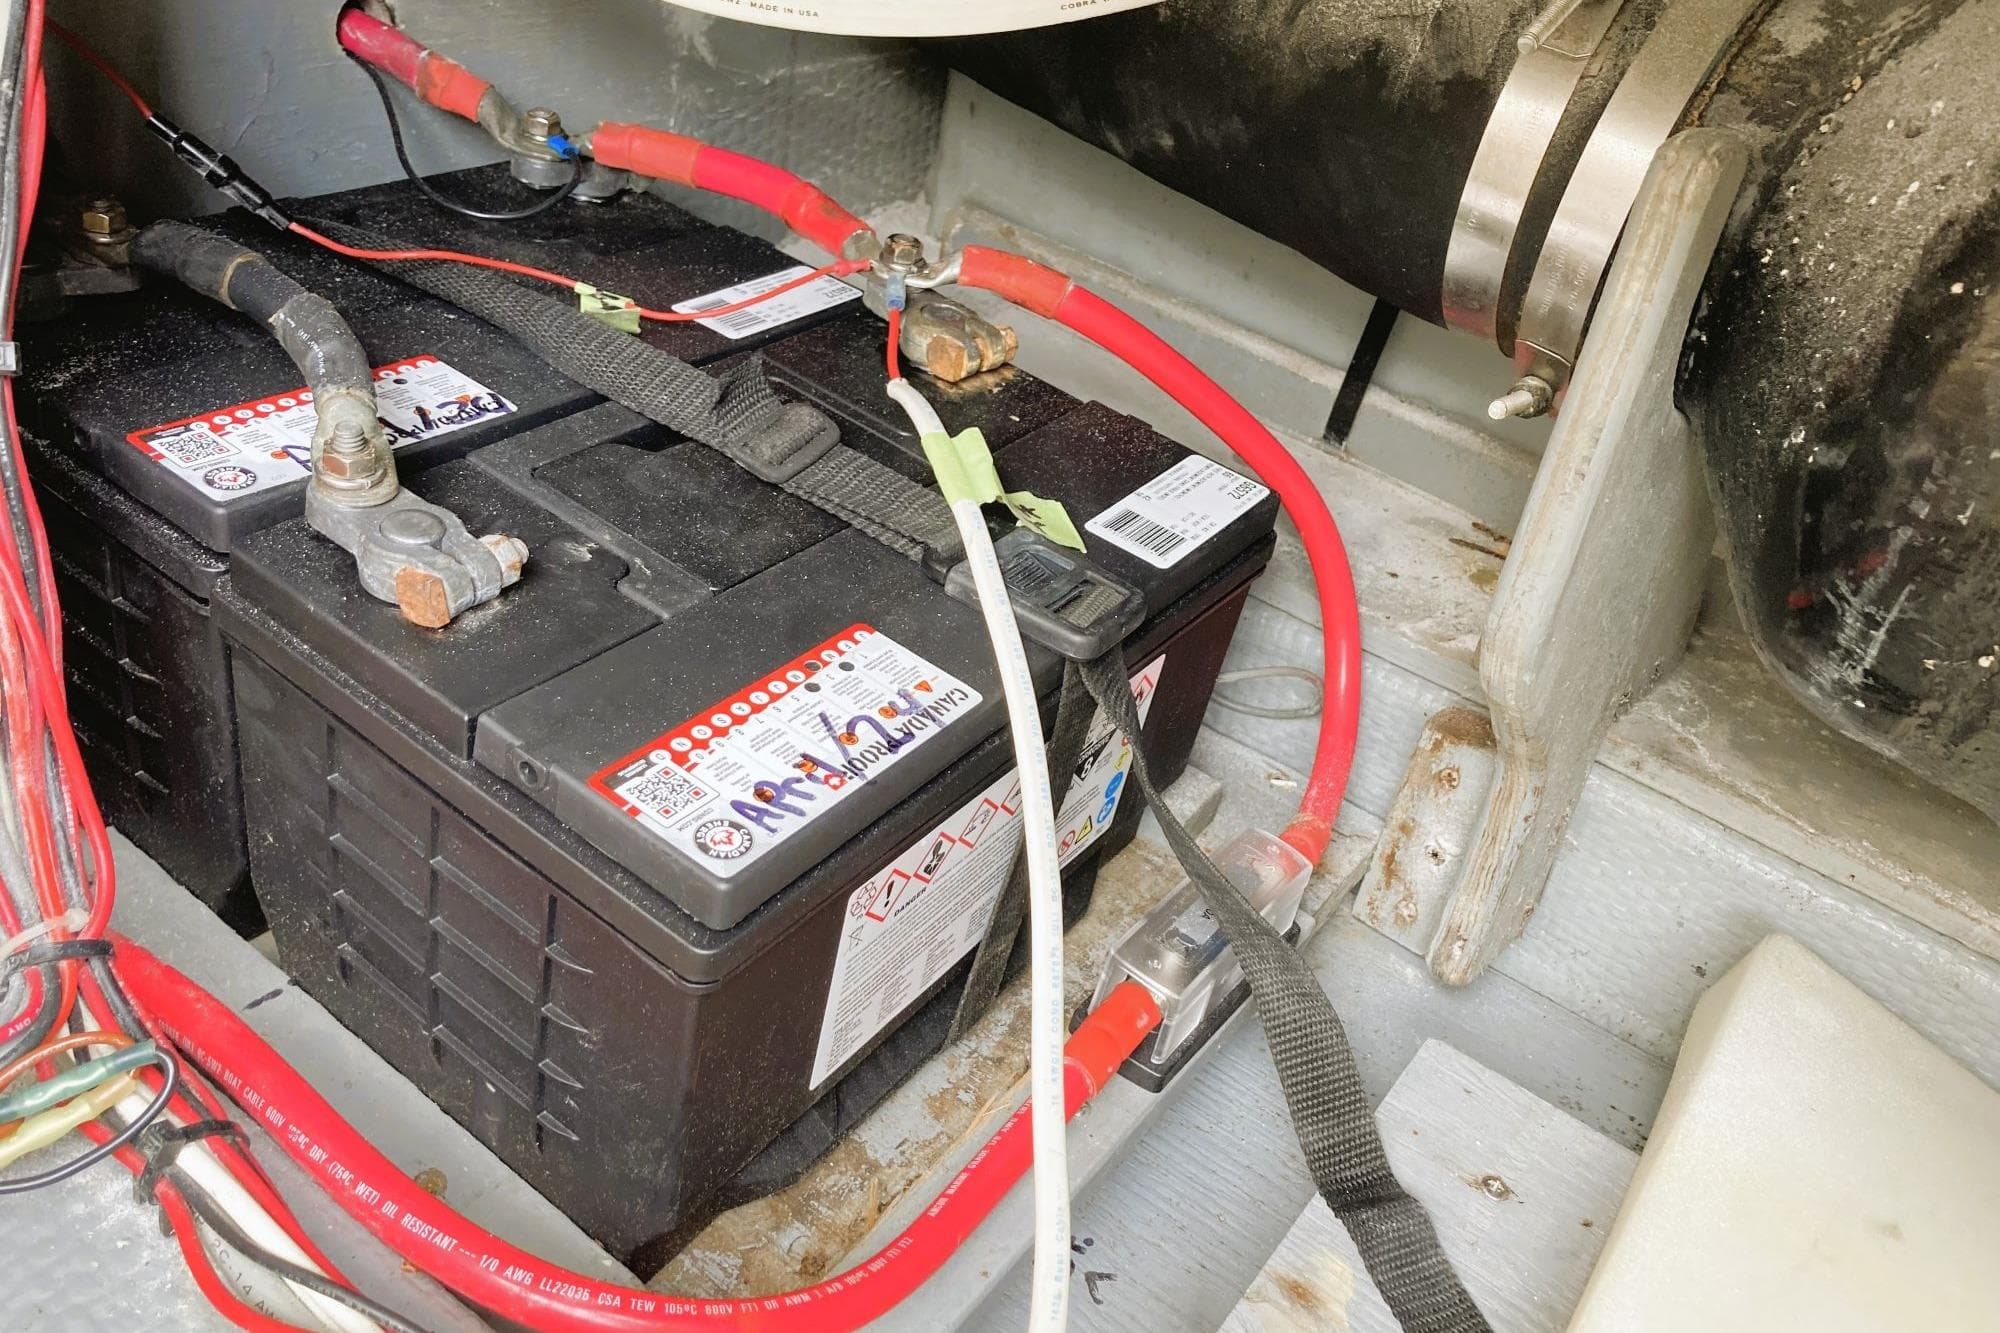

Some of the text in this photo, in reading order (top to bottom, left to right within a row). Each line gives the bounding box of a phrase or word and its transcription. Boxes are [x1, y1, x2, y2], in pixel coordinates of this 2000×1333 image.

[750, 1, 778, 12] MADE
[1060, 0, 1097, 10] COBRA
[893, 686, 969, 741] CANADA
[1080, 756, 1093, 779] 8
[1045, 818, 1055, 848] BOAT
[894, 887, 927, 917] DANGER
[224, 1070, 242, 1089] BOAT
[244, 1087, 265, 1109] CABLE
[309, 1145, 328, 1163] DRY
[355, 1181, 380, 1204] WET)
[382, 1201, 398, 1218] OIL
[401, 1213, 457, 1251] RESISTANT
[480, 1255, 499, 1272] 1/0
[503, 1266, 533, 1285] AWG
[539, 1278, 589, 1301] LL22036
[597, 1293, 620, 1307] CSA
[631, 1298, 655, 1312] TEW
[705, 1305, 732, 1315] 600V
[764, 1300, 779, 1310] OR
[785, 1293, 811, 1306] AWM
